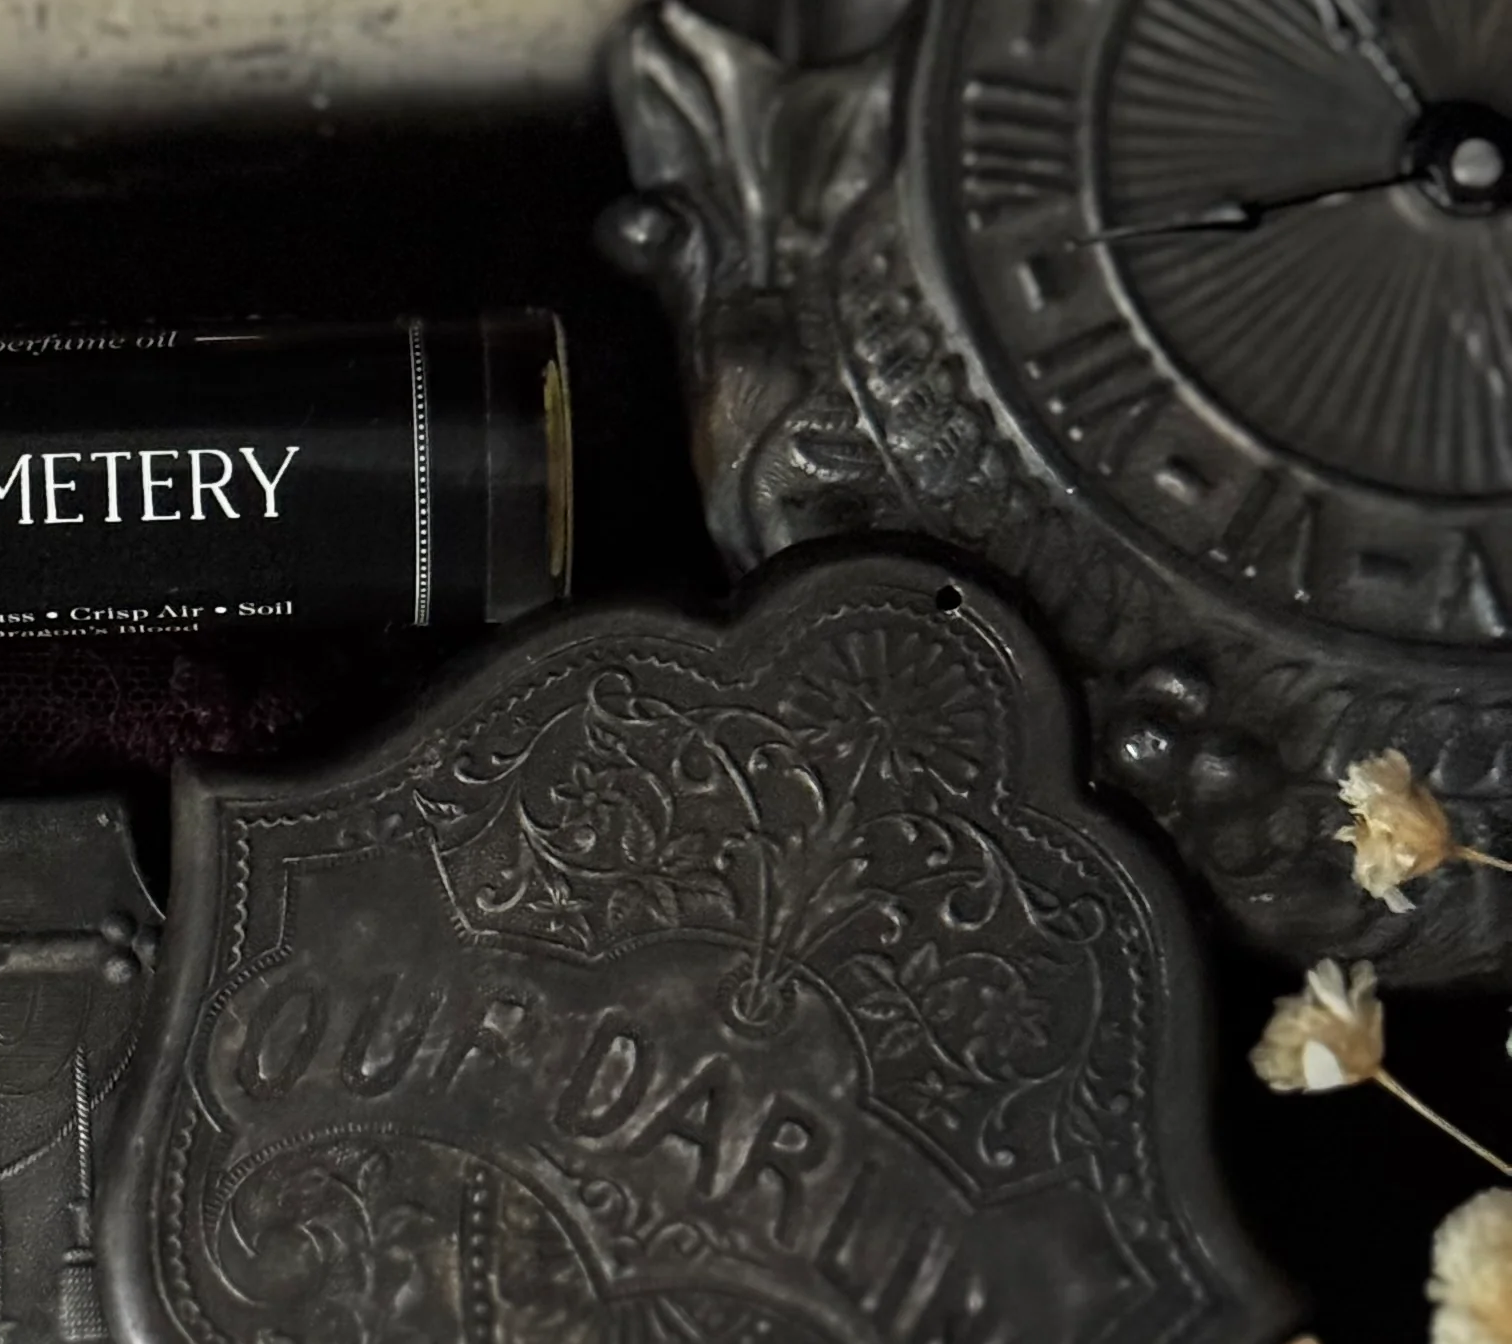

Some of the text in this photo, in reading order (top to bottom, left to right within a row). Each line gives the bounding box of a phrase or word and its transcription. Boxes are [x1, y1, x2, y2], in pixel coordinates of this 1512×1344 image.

[136, 329, 178, 350] oil
[69, 605, 150, 622] Crisp
[156, 604, 205, 619] Air
[238, 600, 294, 617] Soil
[230, 981, 538, 1104] OUR
